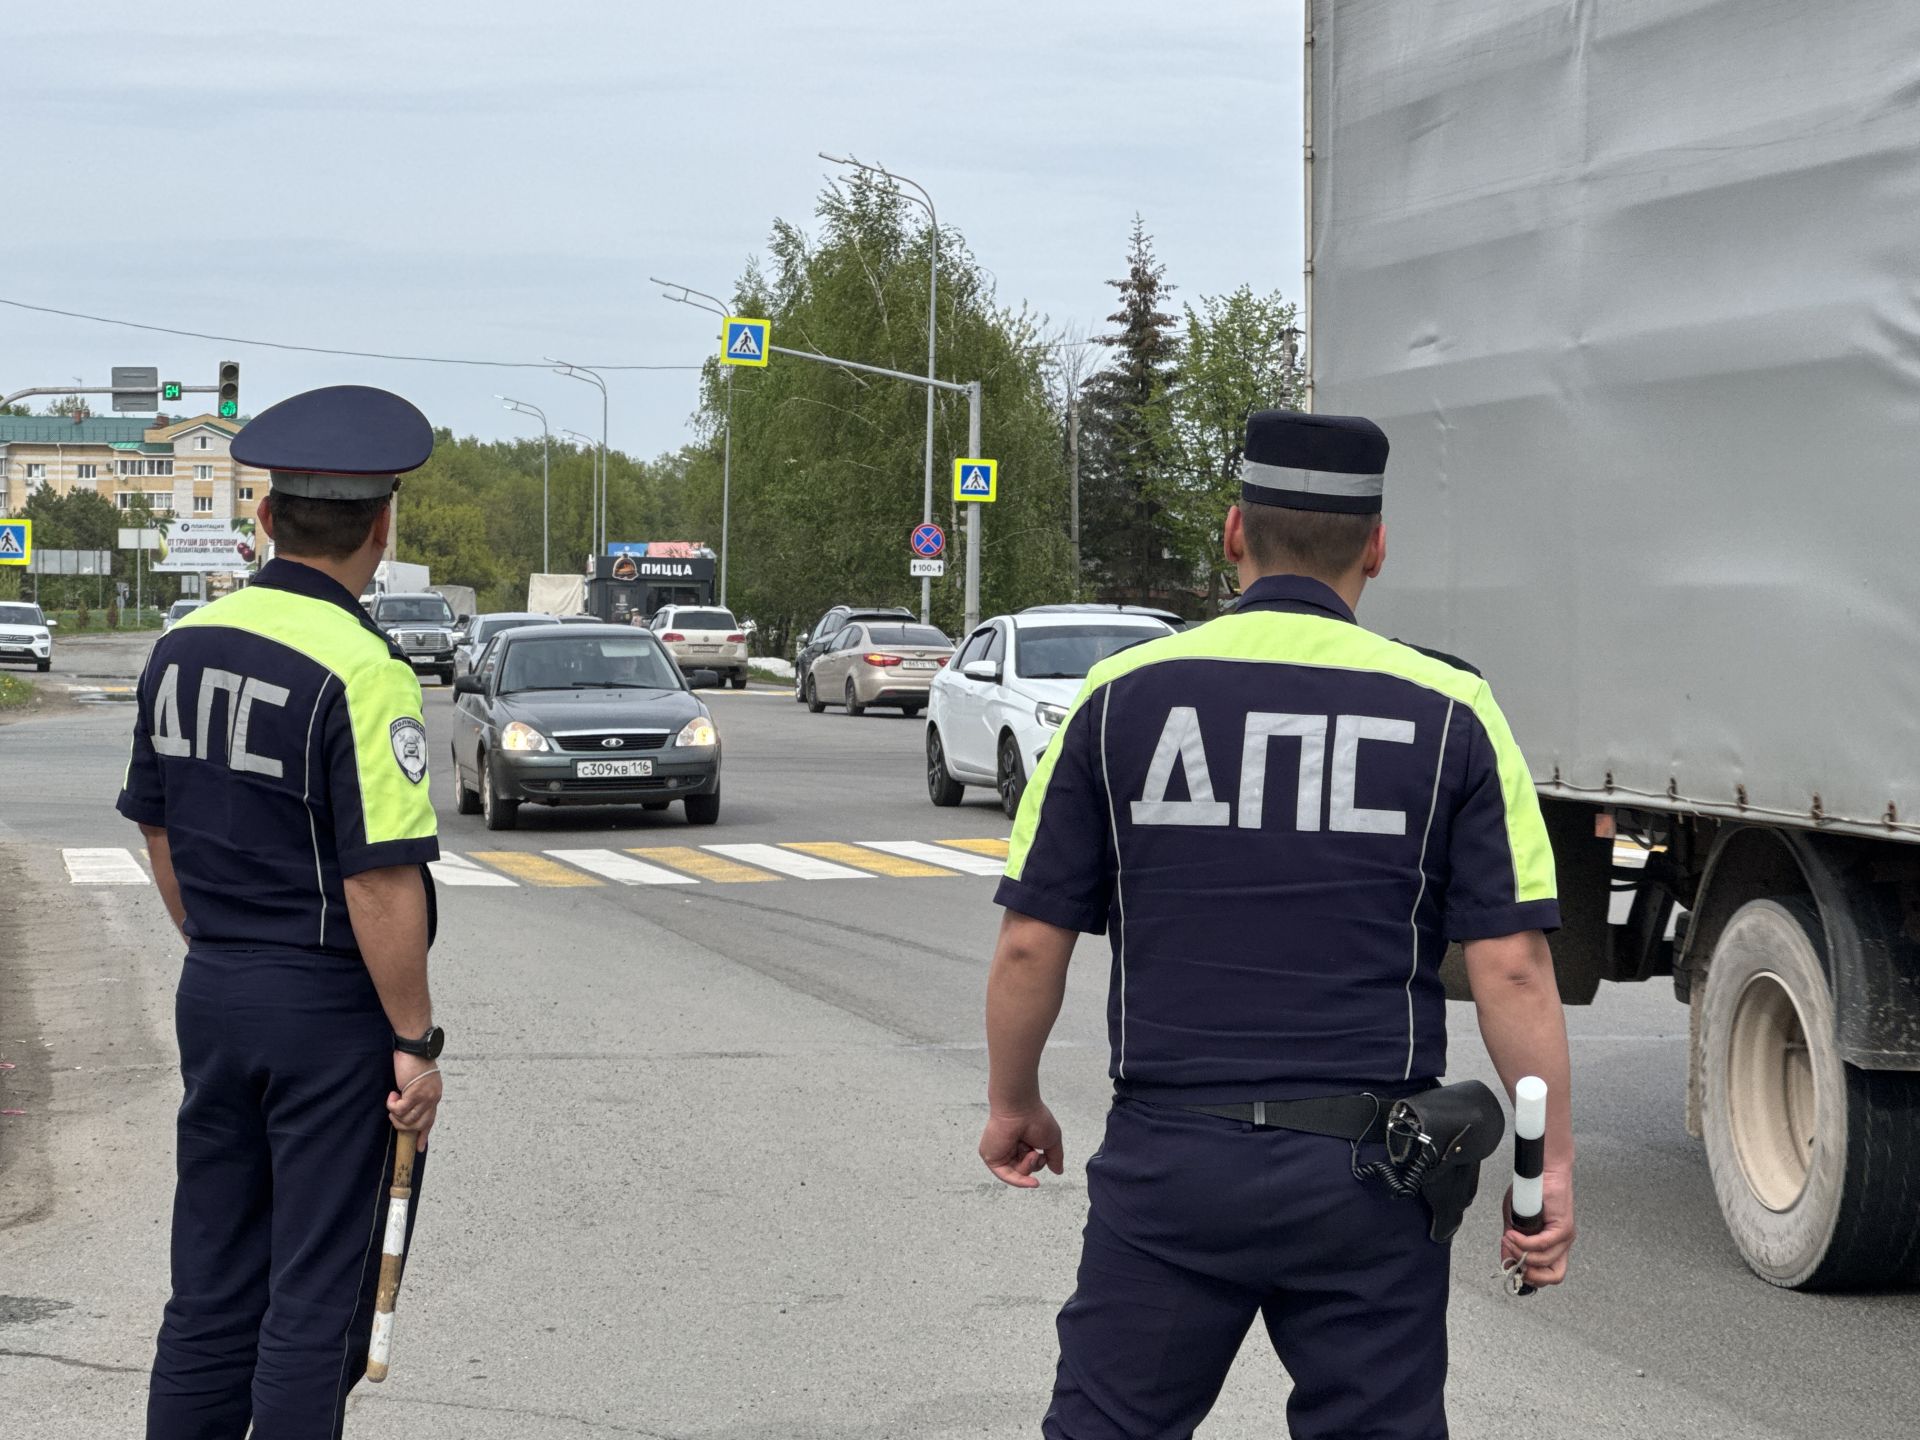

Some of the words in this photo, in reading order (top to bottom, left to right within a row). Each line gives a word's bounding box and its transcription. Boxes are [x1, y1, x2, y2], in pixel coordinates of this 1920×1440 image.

[165, 384, 179, 398] 64
[167, 538, 174, 546] ОТ
[175, 538, 198, 546] ГРУШИ
[199, 538, 208, 547] ДО
[208, 538, 238, 547] ЧЕРЕШНИ
[641, 563, 693, 576] ПИЦЦА
[919, 564, 932, 572] 100
[150, 664, 290, 778] ДПС
[582, 763, 628, 775] С309КВ
[631, 762, 649, 770] 116
[1130, 706, 1416, 835] ДПС
